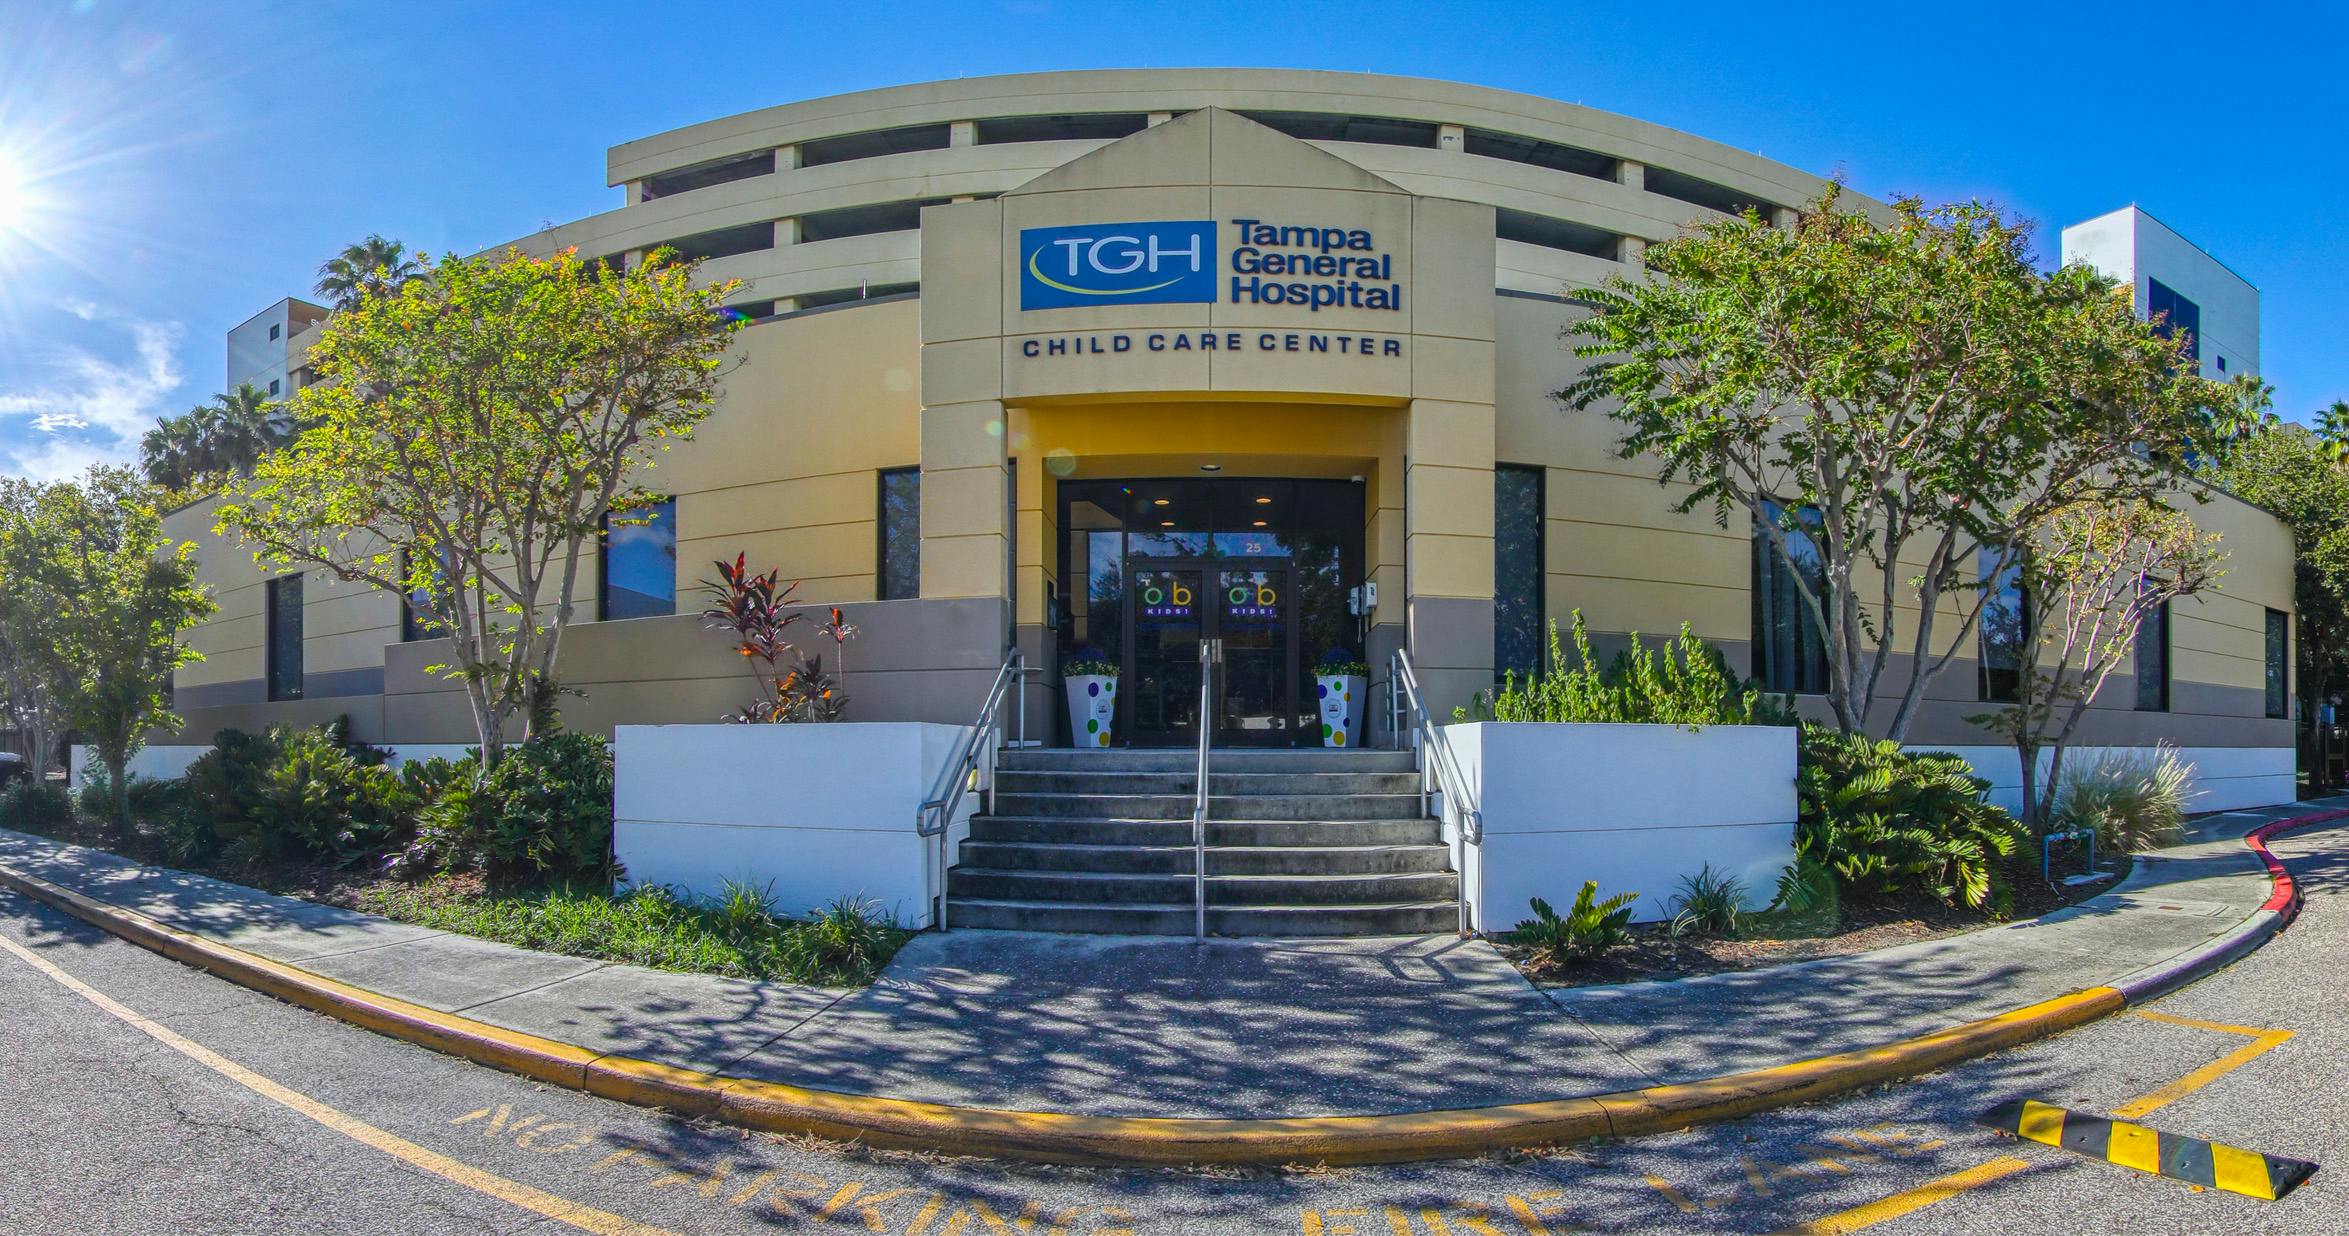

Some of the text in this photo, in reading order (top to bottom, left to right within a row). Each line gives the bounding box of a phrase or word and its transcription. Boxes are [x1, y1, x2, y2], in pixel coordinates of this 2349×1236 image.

[1231, 219, 1373, 254] Tampa
[1053, 233, 1200, 276] TGH
[1231, 247, 1391, 280] General
[1231, 277, 1400, 312] Hospital
[1023, 333, 1400, 357] CHILD CARE CENTER
[1246, 543, 1262, 553] 25
